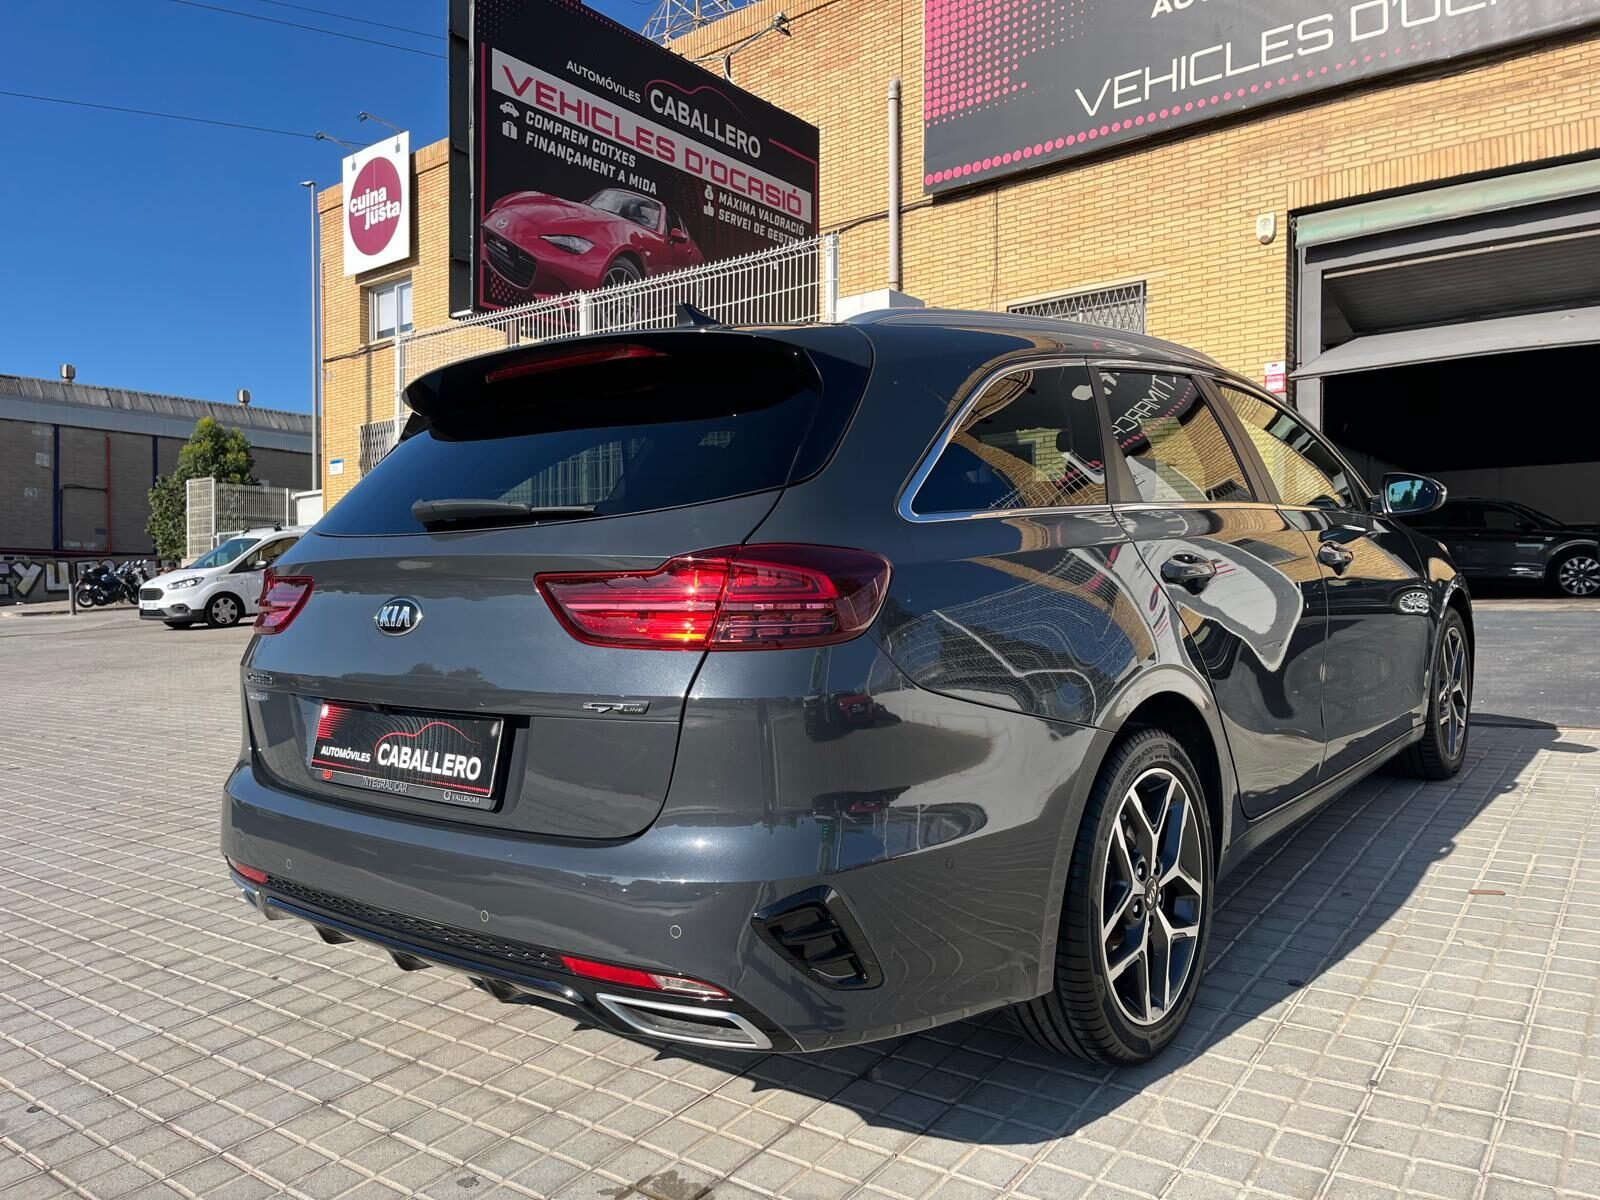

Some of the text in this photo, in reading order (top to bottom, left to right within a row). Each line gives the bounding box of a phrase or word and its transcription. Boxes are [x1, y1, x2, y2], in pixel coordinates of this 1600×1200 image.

[1075, 13, 1334, 117] VEHICLES
[566, 60, 761, 159] AUTOMÓVILES CABALLERO
[501, 64, 802, 216] VEHICLES D'OCASIÓ
[525, 110, 637, 168] COMPREM COTXES
[525, 131, 657, 195] FINANÇAMENT A MIDA
[350, 186, 387, 213] cuina
[364, 200, 401, 231] justa
[718, 188, 805, 237] MÀXIMA VALORACIÓ
[718, 208, 751, 231] SERVEI
[753, 222, 765, 237] DE
[379, 605, 411, 628] KIA
[320, 743, 482, 781] AUTOMÓVILES CABALLERO
